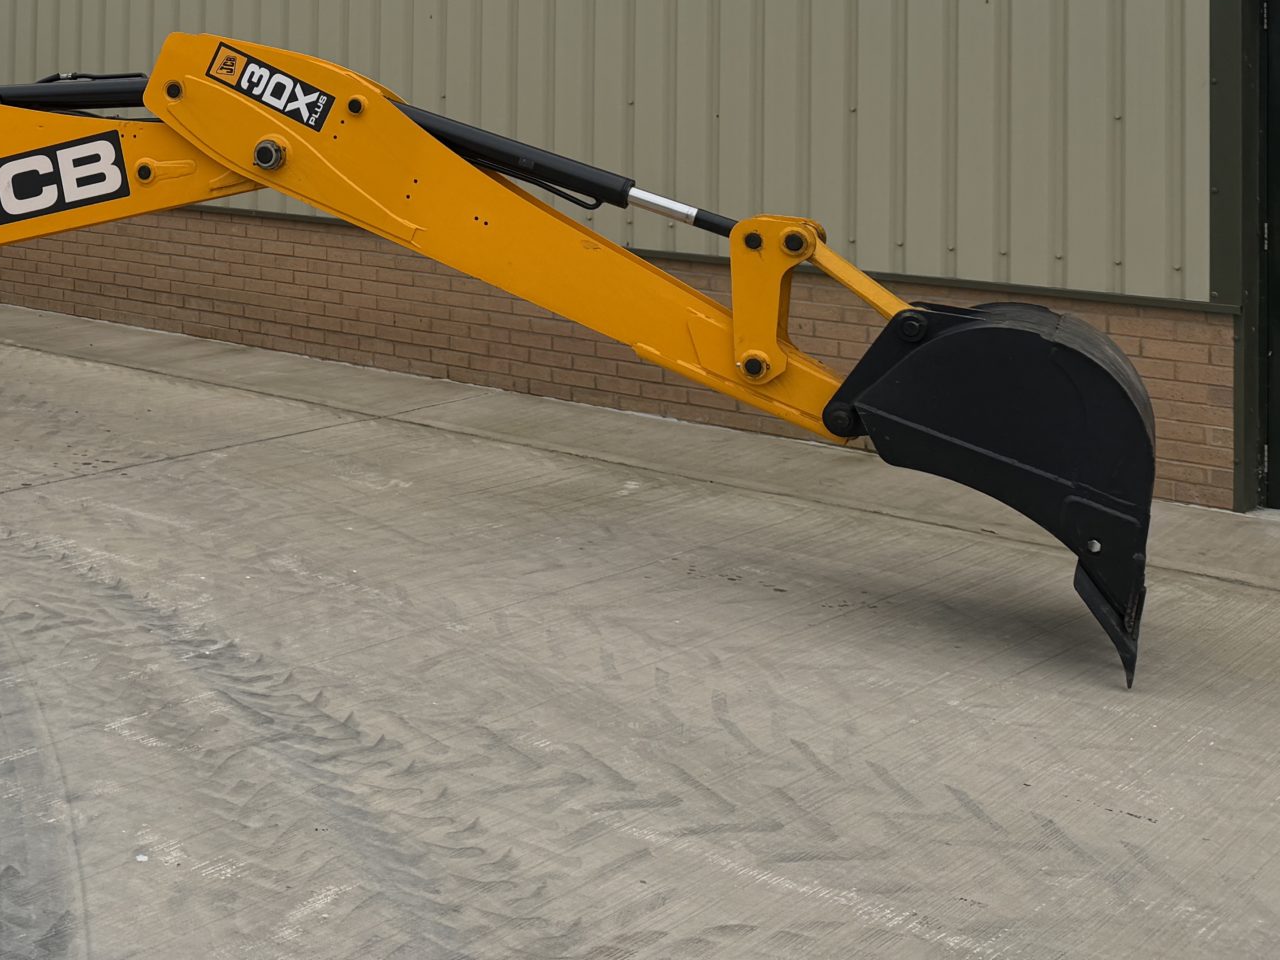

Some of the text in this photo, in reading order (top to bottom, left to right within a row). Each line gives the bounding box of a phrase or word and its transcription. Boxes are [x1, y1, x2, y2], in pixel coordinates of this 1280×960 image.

[219, 56, 237, 74] JCB
[240, 63, 320, 123] 30X
[308, 95, 327, 126] PLUS
